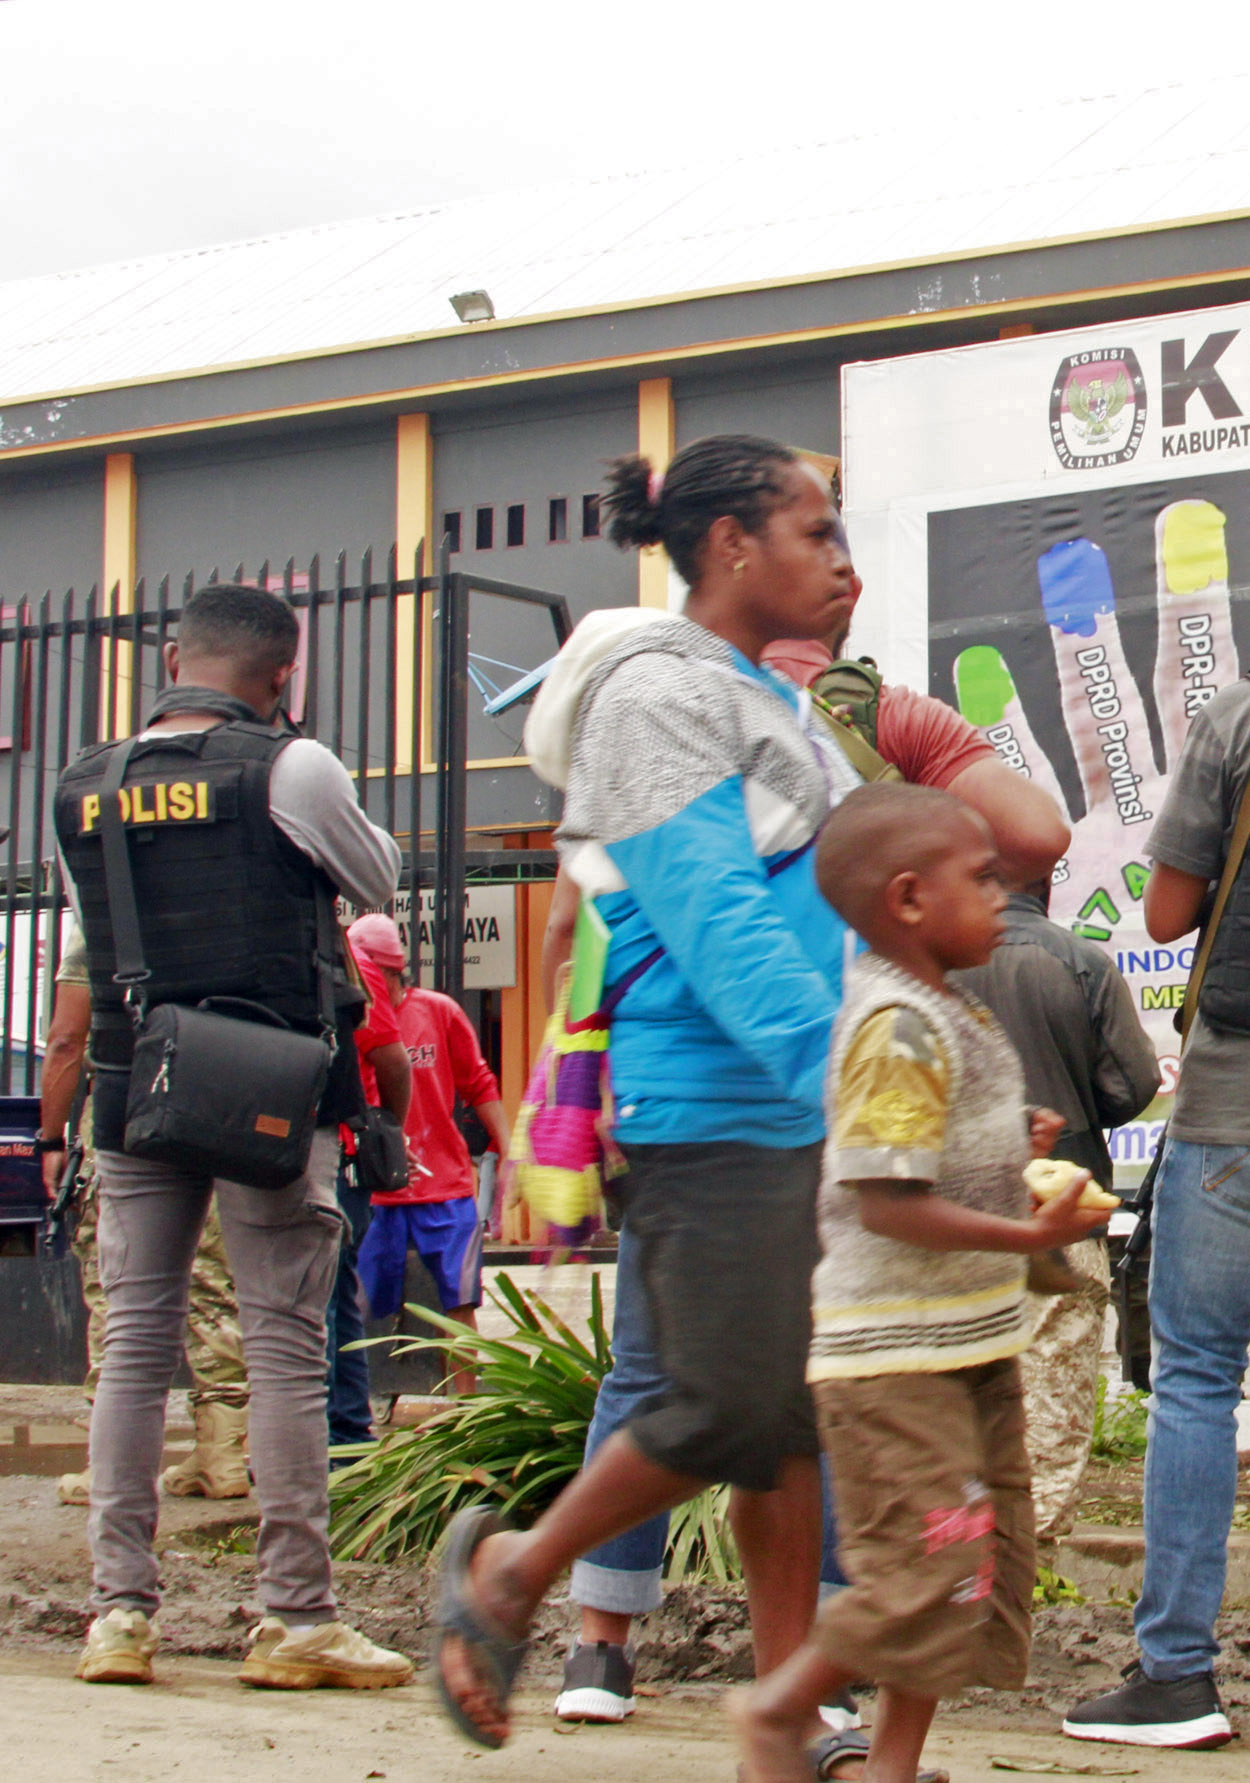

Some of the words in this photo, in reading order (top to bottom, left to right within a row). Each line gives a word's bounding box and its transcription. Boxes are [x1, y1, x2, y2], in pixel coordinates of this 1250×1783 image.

[1070, 348, 1125, 367] KOMISI
[1051, 420, 1118, 468] PEMILIHAN
[1122, 408, 1147, 460] UMUM
[1076, 645, 1122, 721] DPRD
[1097, 720, 1153, 826] Provinsi
